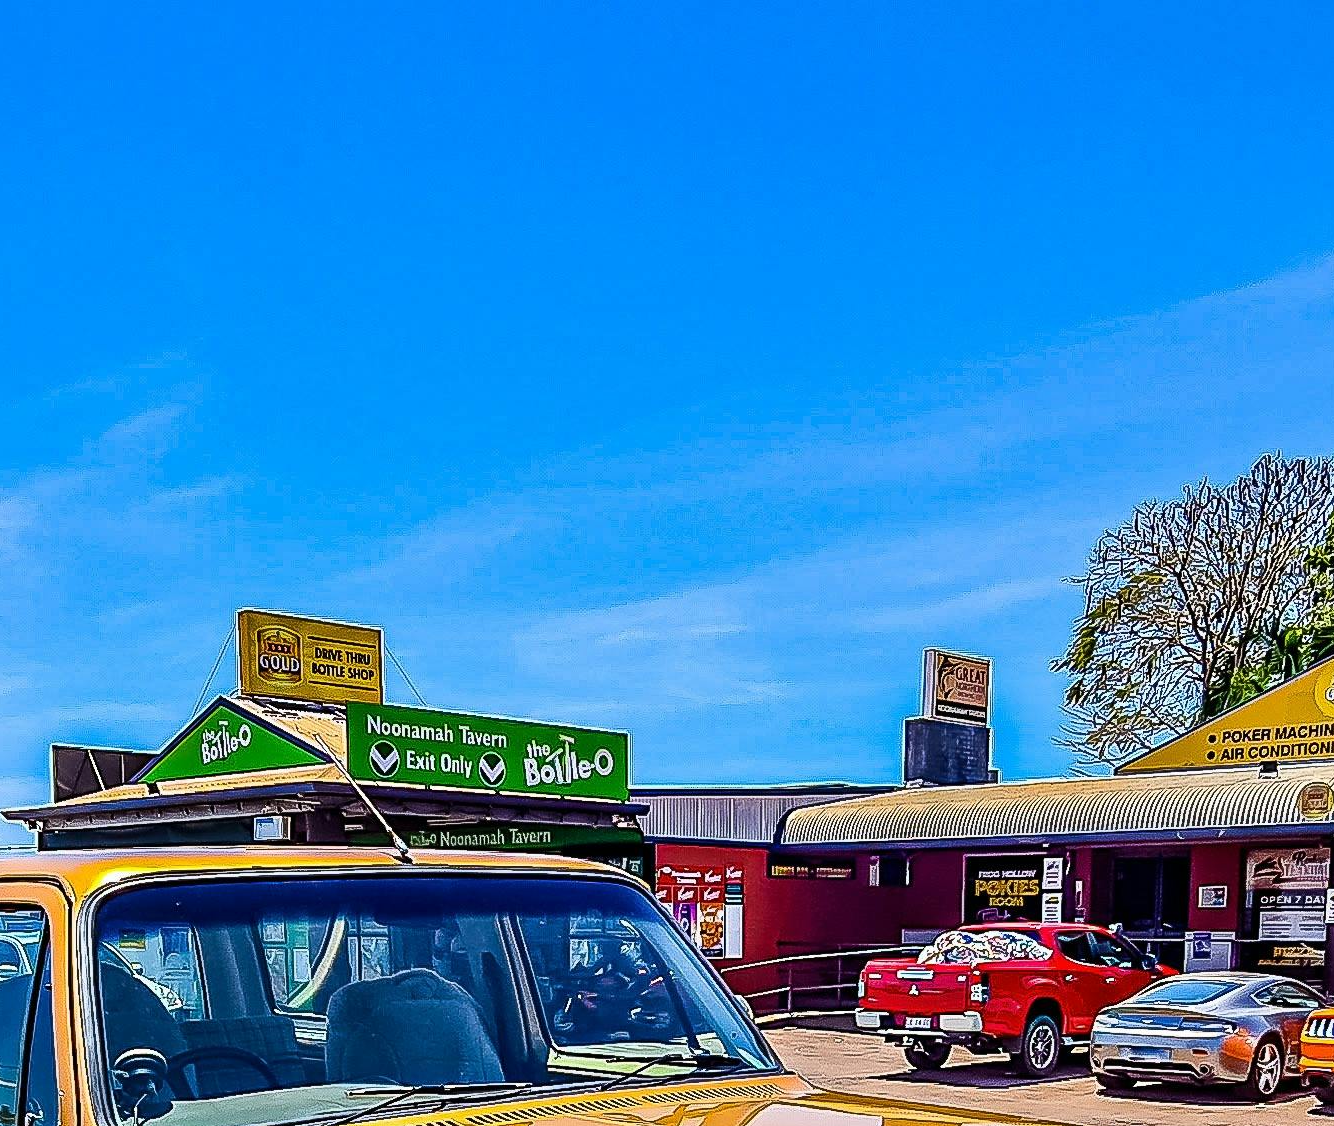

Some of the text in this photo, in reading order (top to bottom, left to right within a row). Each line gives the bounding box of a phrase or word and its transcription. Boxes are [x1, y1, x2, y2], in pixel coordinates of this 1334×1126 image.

[259, 654, 300, 672] GOLD
[314, 646, 371, 666] DRIVE THRU
[311, 661, 375, 681] BOTTLE SHOP
[955, 666, 987, 686] GREAT
[367, 714, 508, 748] Noonamah Tavern
[1221, 729, 1271, 744] POKER
[526, 739, 551, 758] the
[1220, 747, 1245, 761] AIR
[406, 750, 473, 779] Exit Only
[440, 828, 505, 847] Noonamah
[508, 828, 551, 844] Tavern
[1002, 869, 1037, 878] HOLLOW
[974, 879, 1040, 896] POKIES
[1260, 895, 1292, 904] OPEN
[1295, 895, 1302, 904] 7
